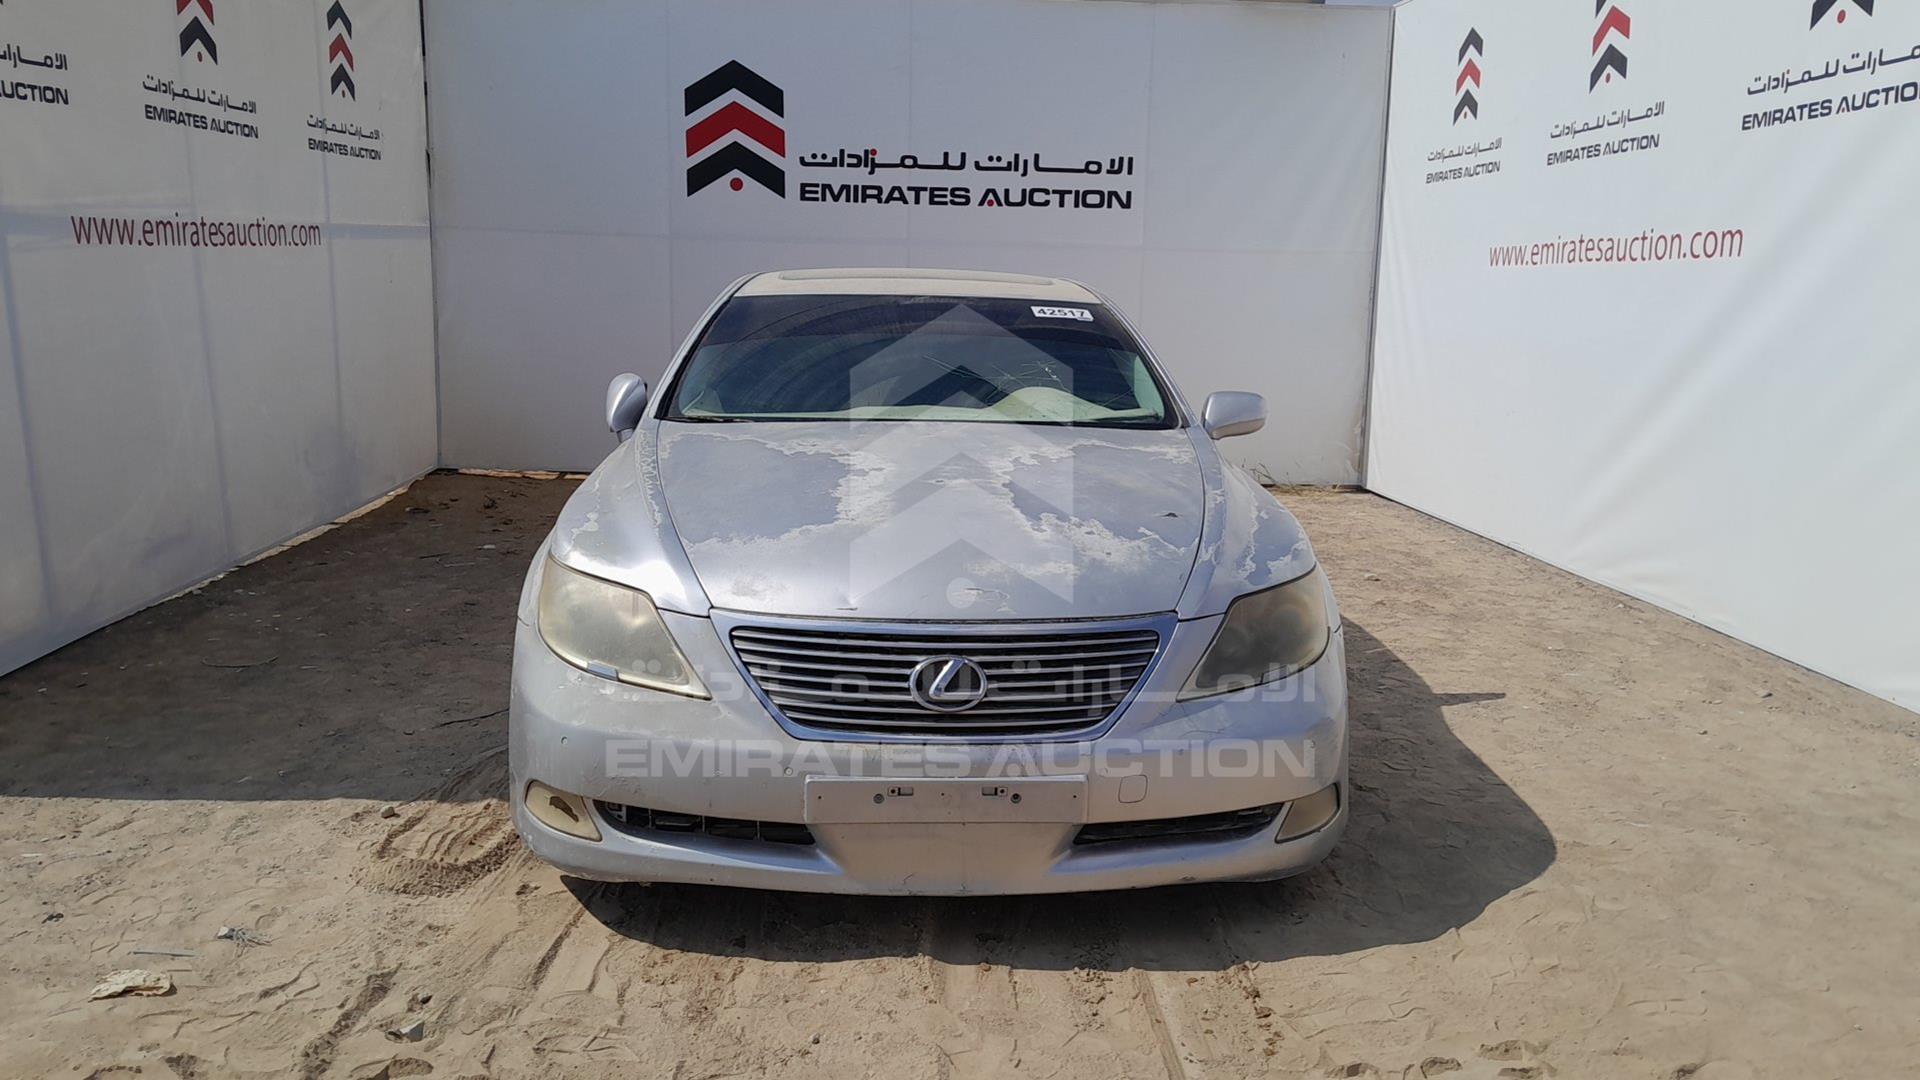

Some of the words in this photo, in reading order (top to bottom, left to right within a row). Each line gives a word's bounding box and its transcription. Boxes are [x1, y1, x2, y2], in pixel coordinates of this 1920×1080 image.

[0, 80, 69, 105] UCTION
[1741, 98, 1833, 131] EMIRATES
[1836, 81, 1920, 114] AUCTIO
[144, 104, 208, 130] EMIRATES
[210, 118, 259, 139] AUCTION
[308, 138, 348, 156] EMIRATES
[350, 146, 381, 160] AUCTION
[799, 148, 967, 175] للمزادات
[1546, 143, 1601, 166] EMIRATES
[1602, 133, 1660, 156] AUCTION
[974, 153, 1134, 177] الامارات
[1425, 167, 1462, 184] EMIRATES
[1463, 160, 1501, 178] AUCTION
[799, 182, 971, 206] EMIRATES
[977, 187, 1132, 209] AUCTION
[71, 212, 322, 247] www.emiratesauction.com
[1489, 228, 1744, 267] www.emiratesauction.com
[1037, 308, 1085, 318] 42517
